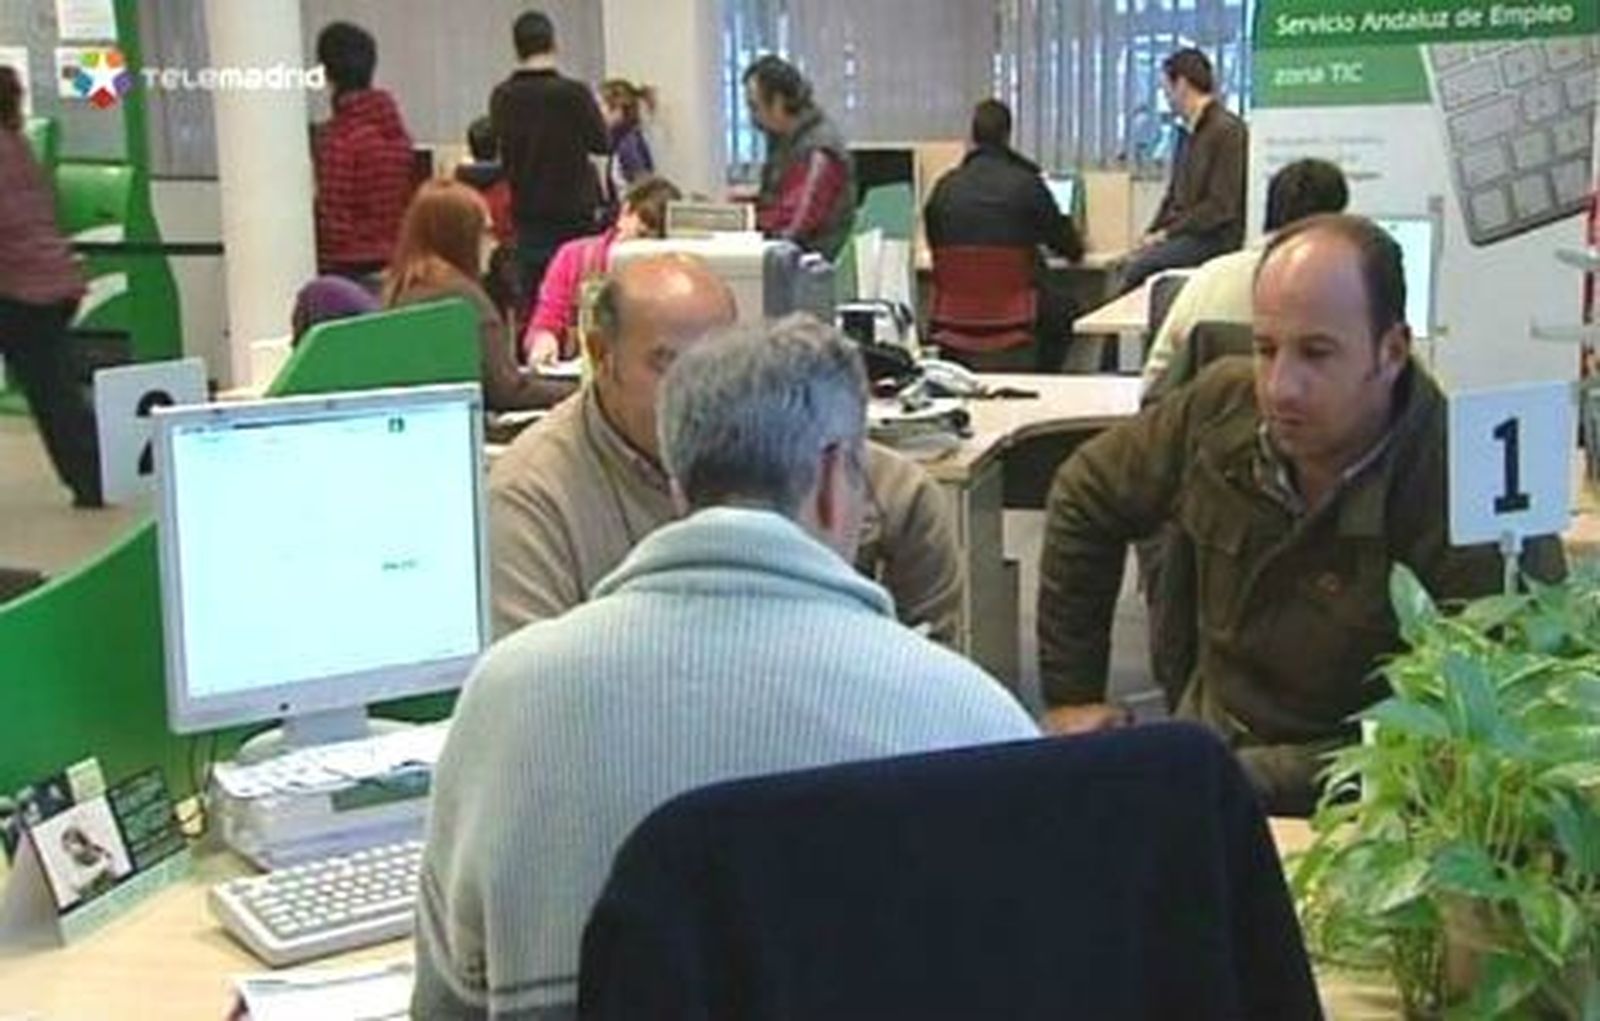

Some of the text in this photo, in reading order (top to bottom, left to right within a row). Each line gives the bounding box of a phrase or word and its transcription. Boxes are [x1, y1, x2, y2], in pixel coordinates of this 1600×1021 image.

[1275, 3, 1574, 36] Servicio Andaluz de Empleo
[1274, 61, 1364, 86] zona TIC
[1493, 416, 1531, 516] 1
